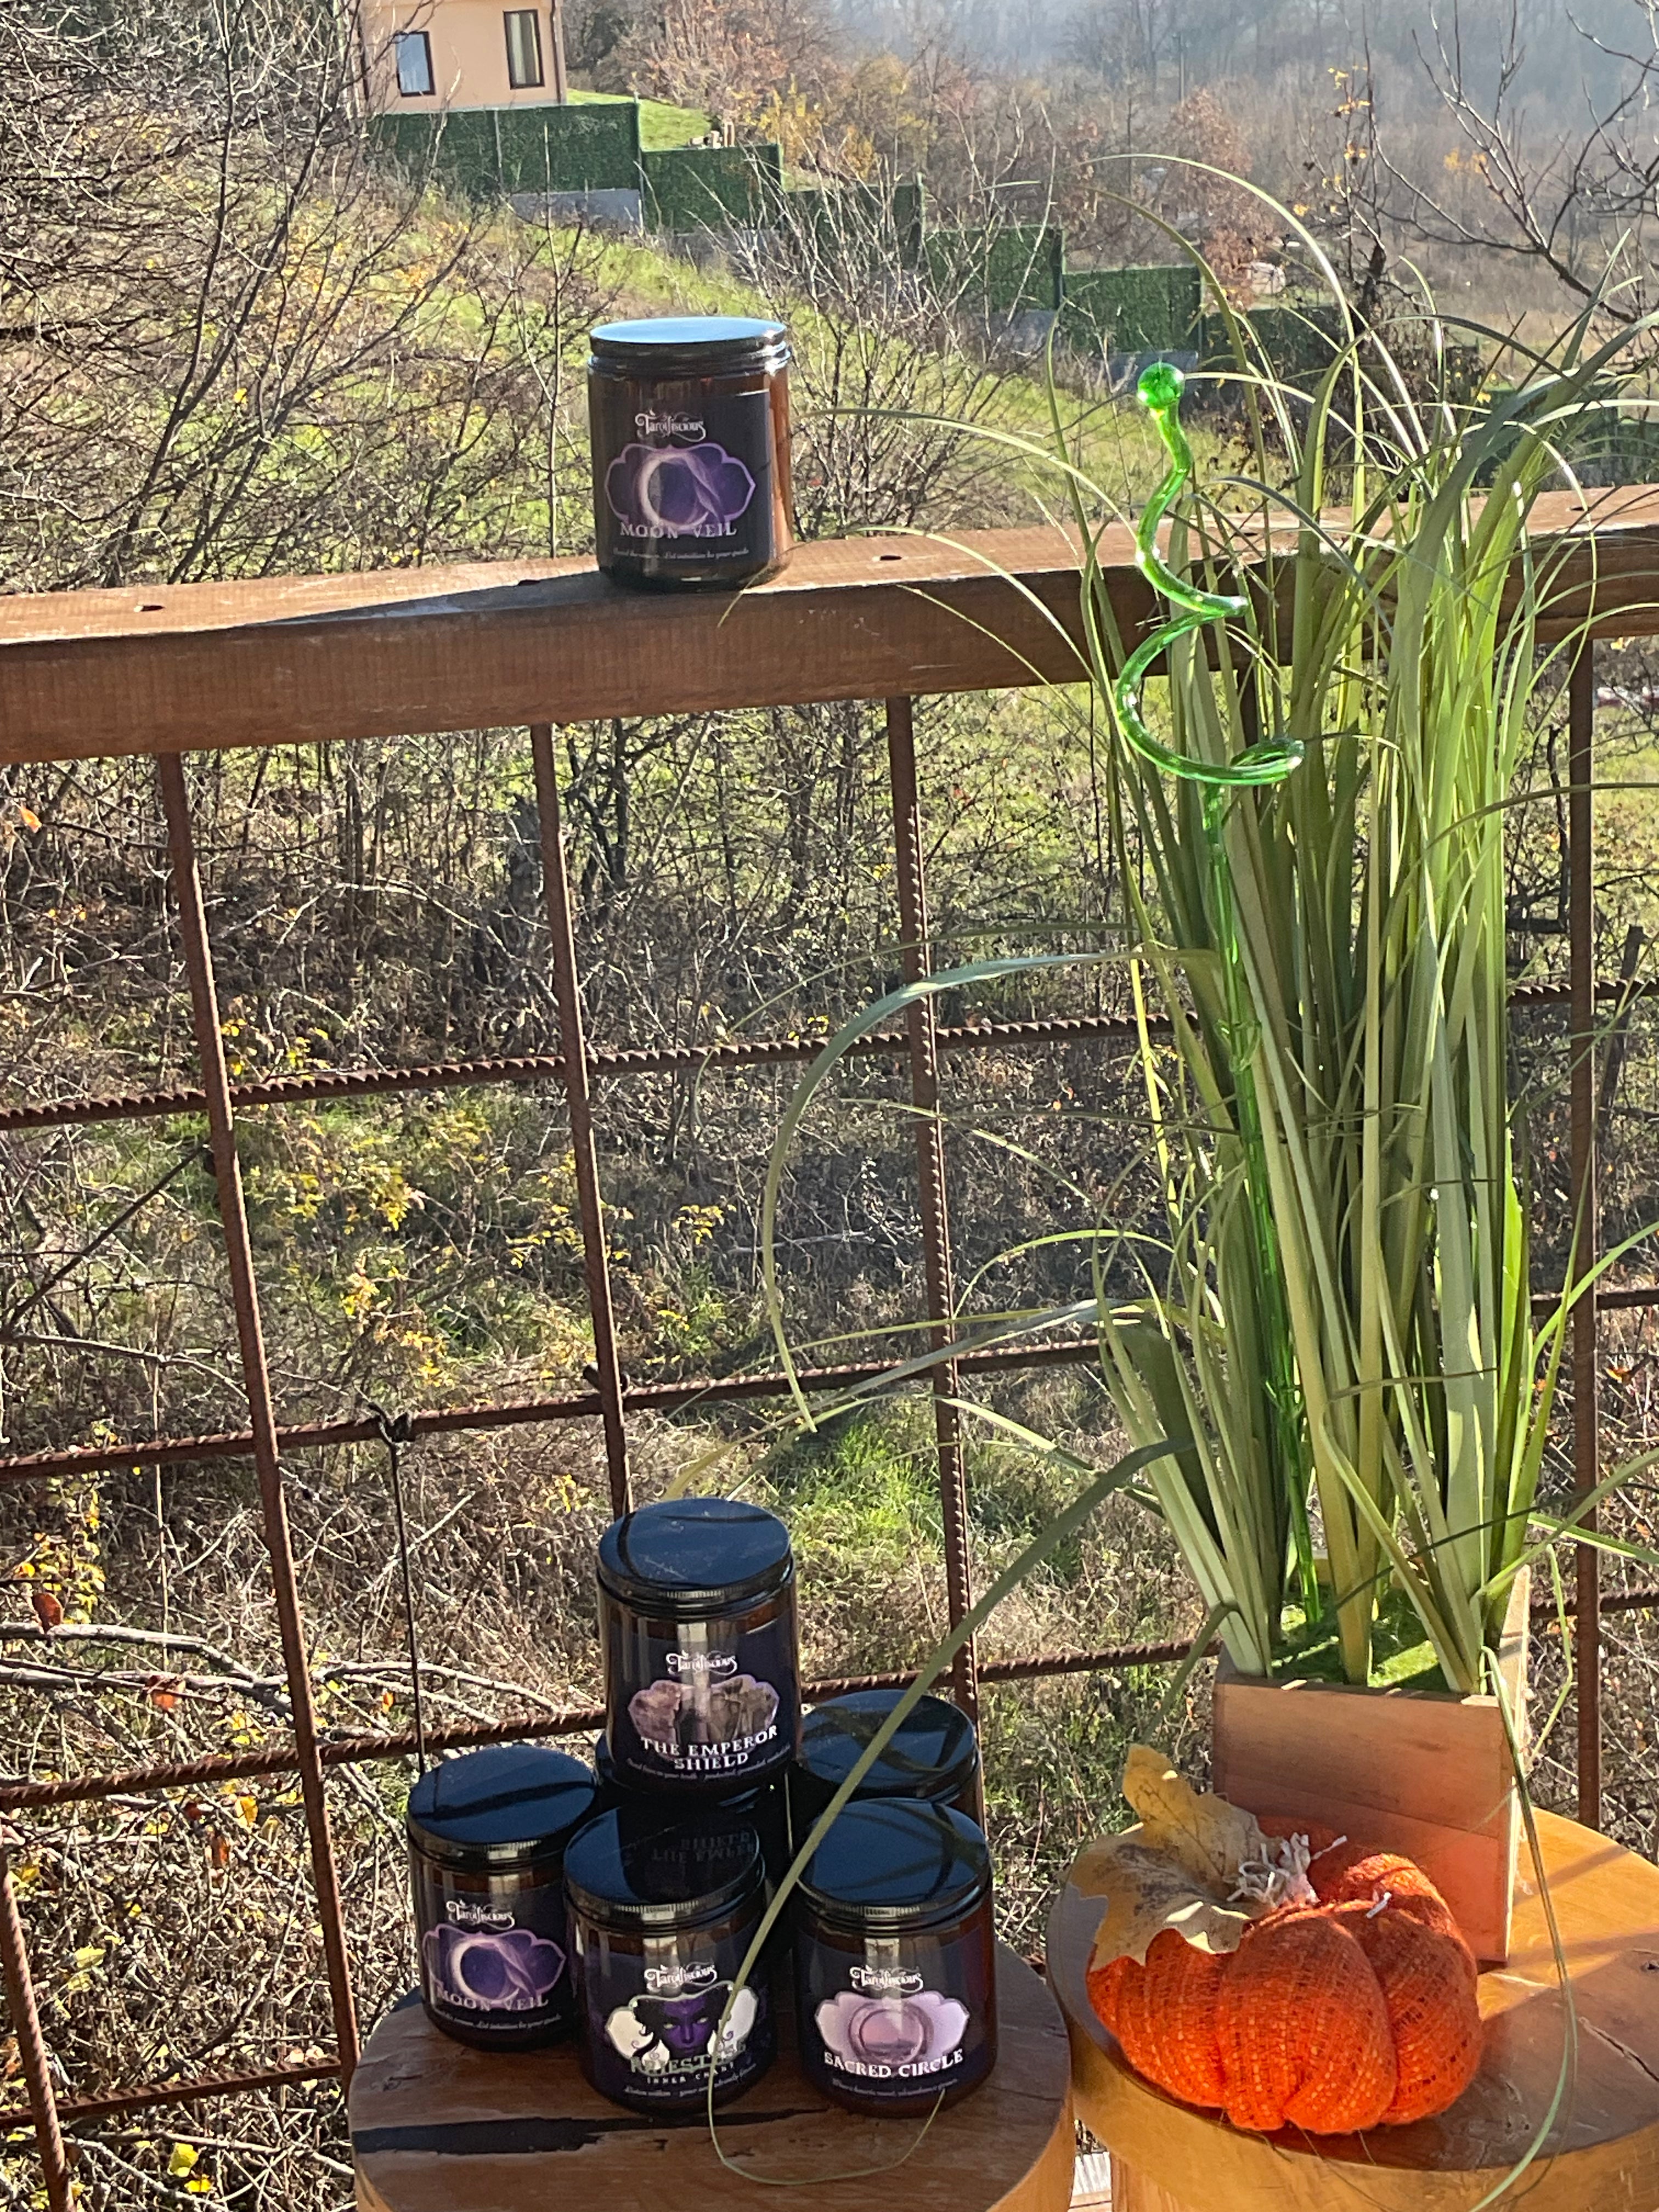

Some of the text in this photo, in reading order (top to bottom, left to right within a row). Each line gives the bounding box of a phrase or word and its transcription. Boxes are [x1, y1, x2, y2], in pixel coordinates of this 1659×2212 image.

[620, 522, 737, 539] MOON VEIL
[641, 1725, 777, 1756] THE EMPEROR
[674, 1752, 748, 1771] SHIELD
[436, 1984, 549, 2011] MOON VEIL
[824, 2048, 963, 2078] SACRED CIRCLE
